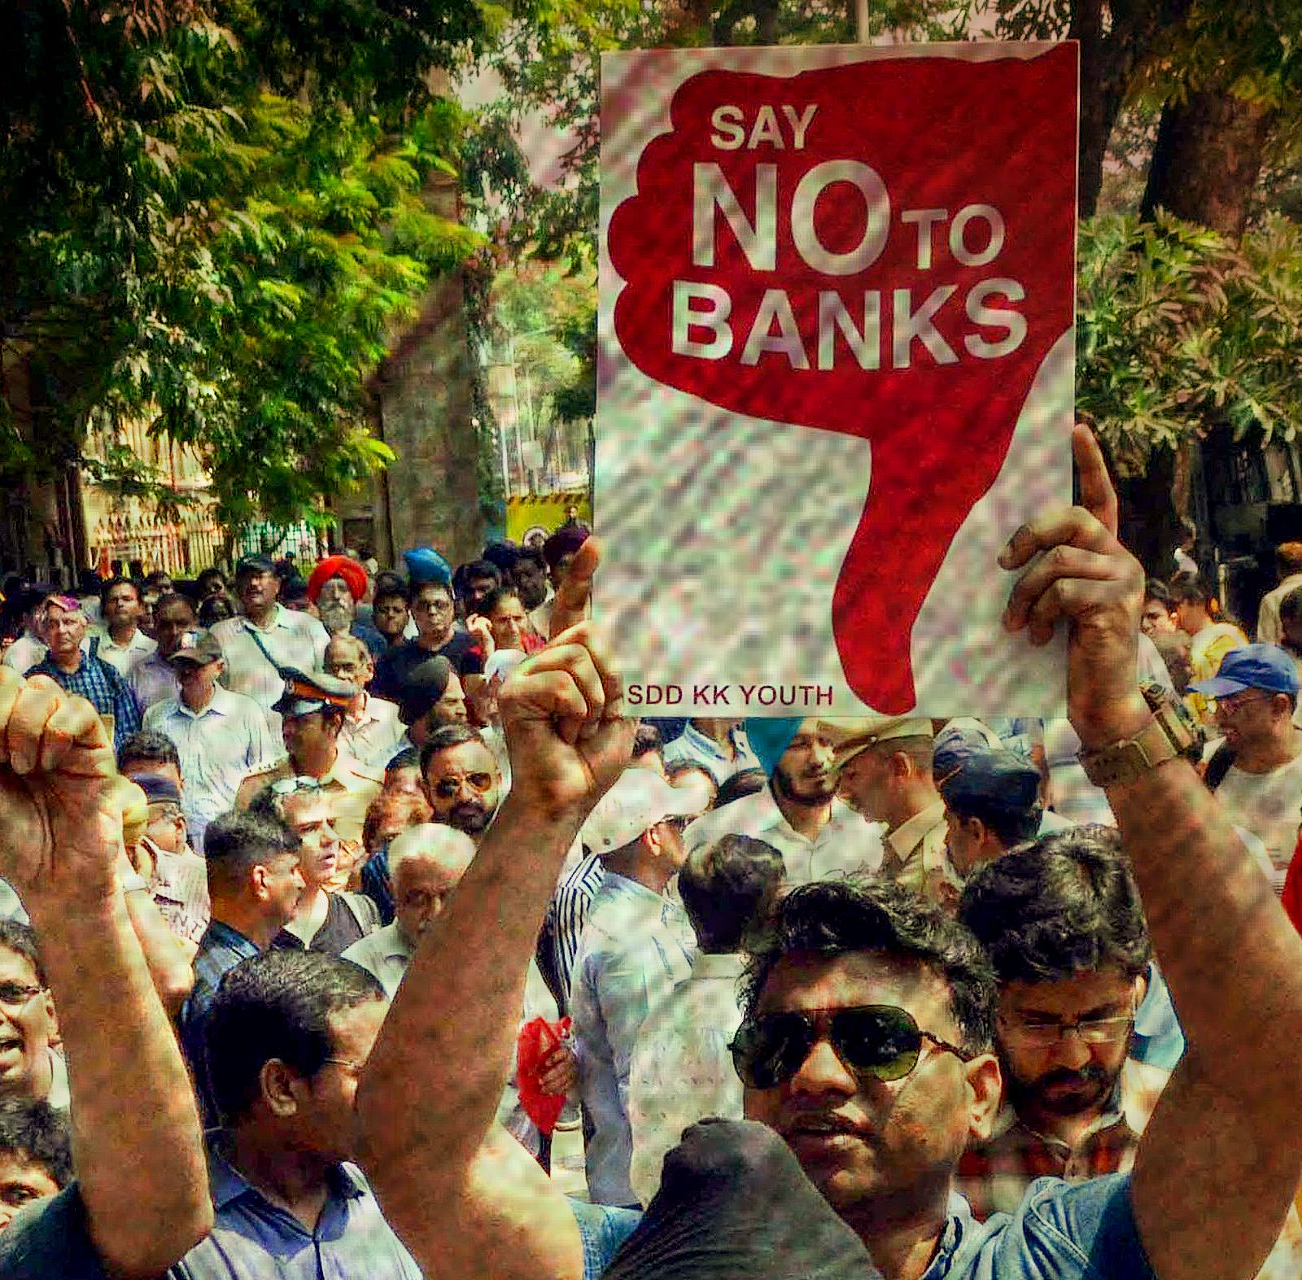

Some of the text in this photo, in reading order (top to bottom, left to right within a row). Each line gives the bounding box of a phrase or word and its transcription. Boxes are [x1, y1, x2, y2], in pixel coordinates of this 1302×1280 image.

[709, 103, 819, 152] SAY
[692, 158, 1007, 276] NO TO
[671, 276, 1029, 372] BANKS
[626, 683, 834, 706] SDD KK YOUTH
